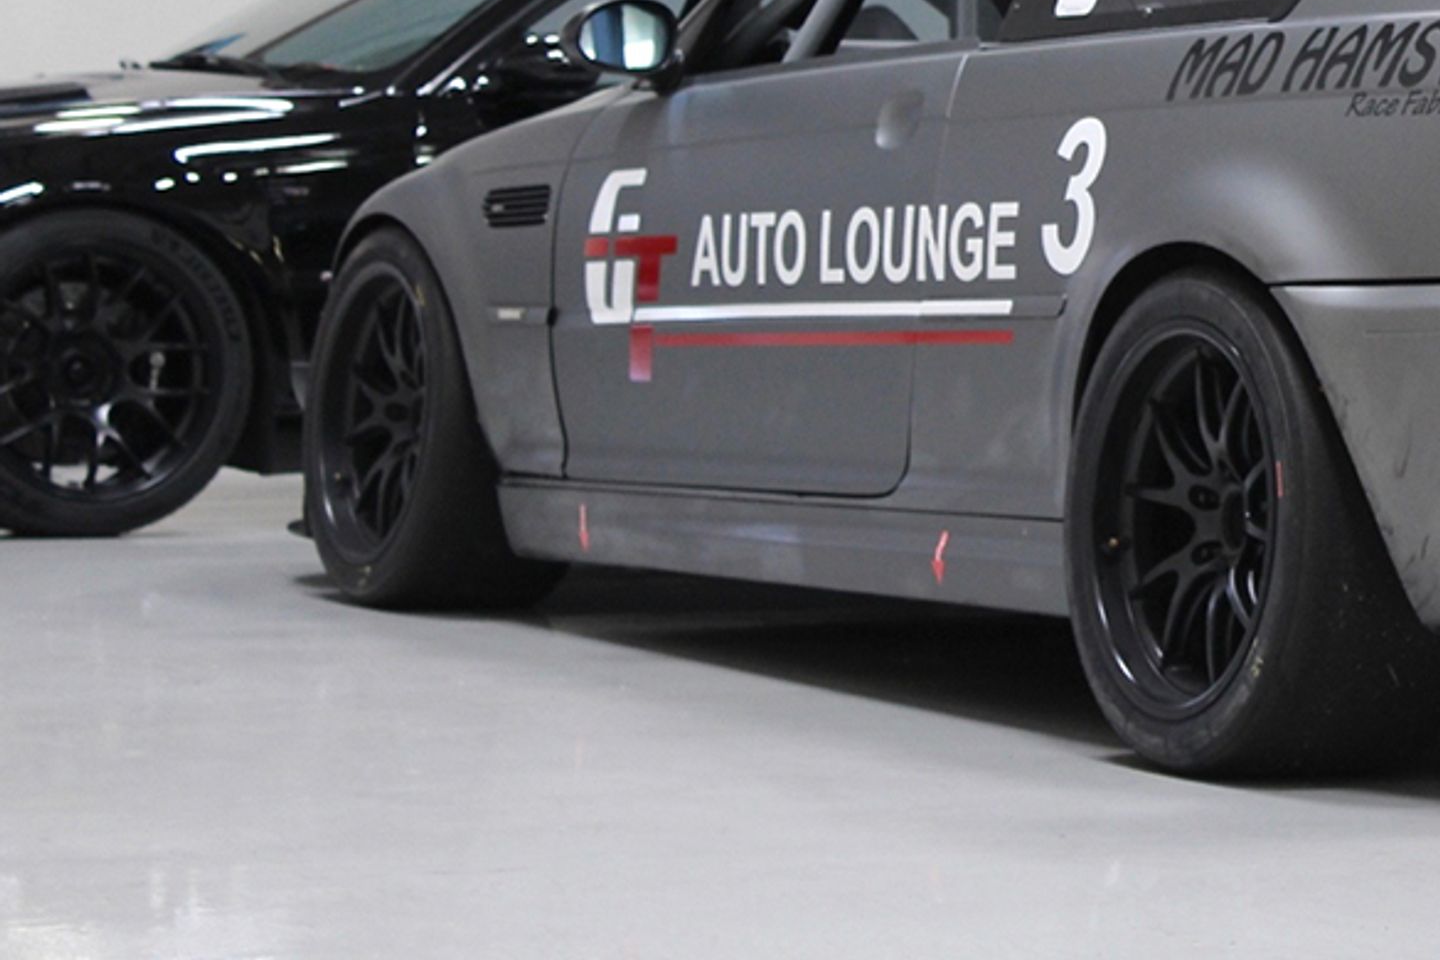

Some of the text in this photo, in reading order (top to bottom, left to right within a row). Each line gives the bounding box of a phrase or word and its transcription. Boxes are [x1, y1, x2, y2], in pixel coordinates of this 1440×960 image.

[1165, 31, 1285, 102] MAD
[1345, 91, 1400, 117] Race
[1041, 117, 1107, 275] 3
[691, 210, 807, 288] AUTO
[819, 202, 1020, 284] LOUNGE
